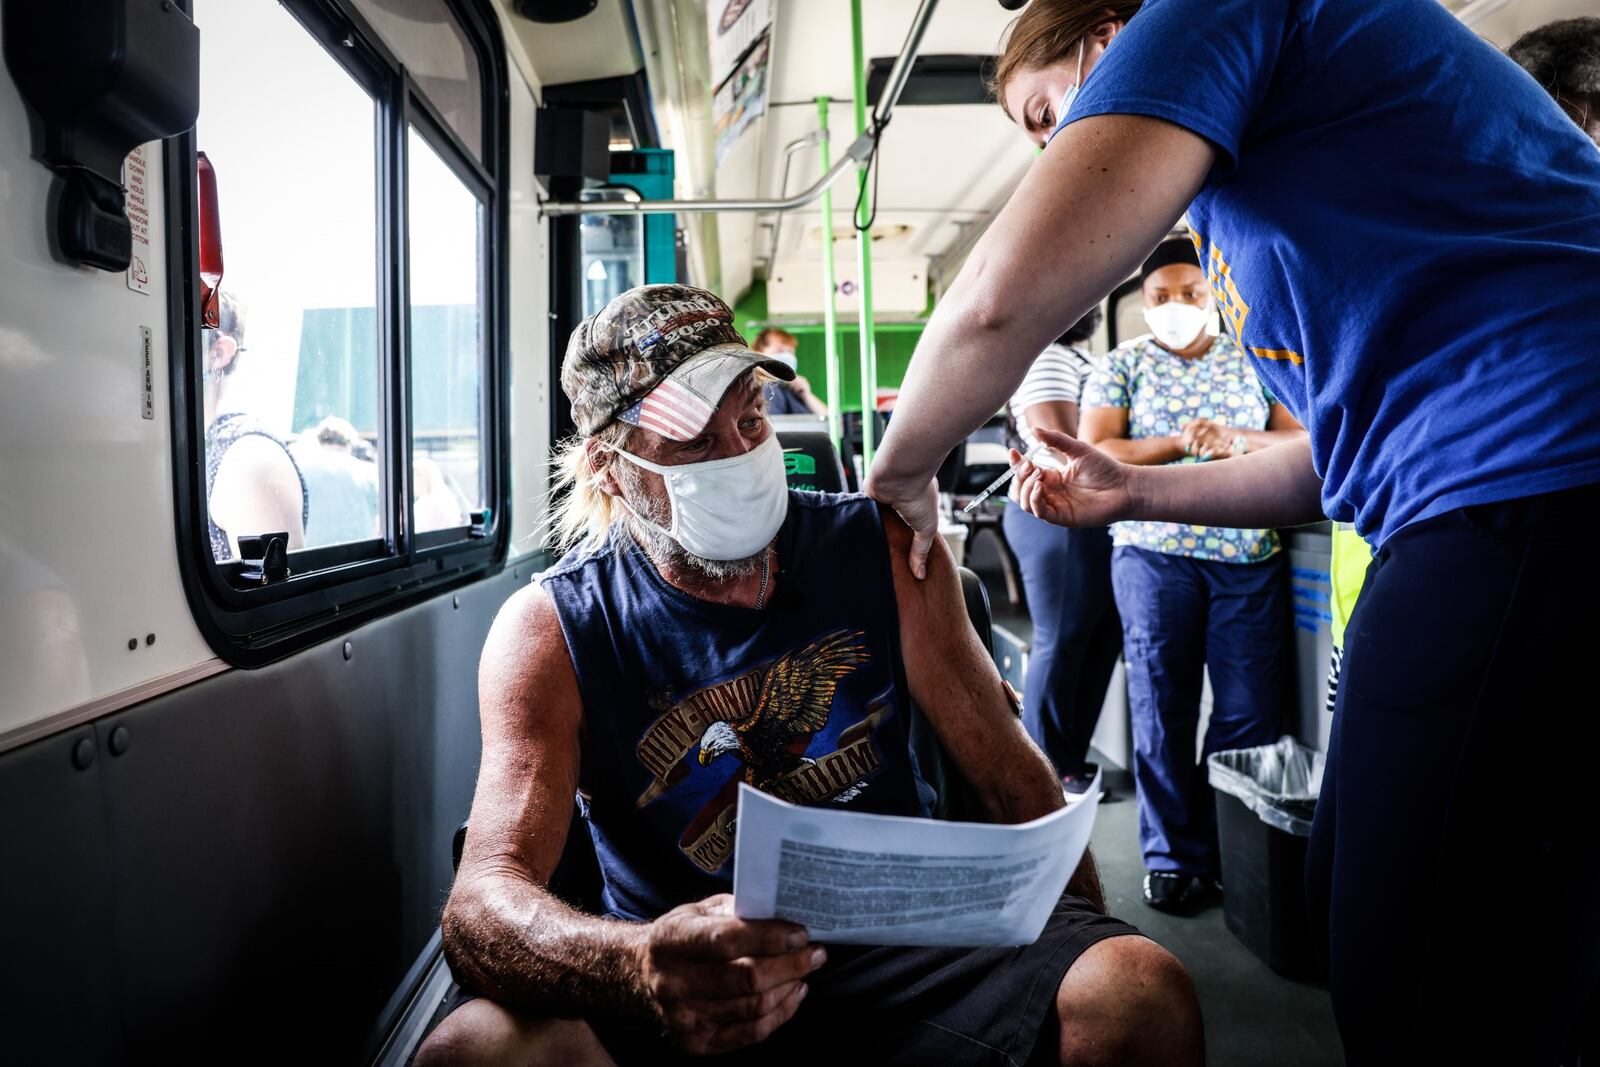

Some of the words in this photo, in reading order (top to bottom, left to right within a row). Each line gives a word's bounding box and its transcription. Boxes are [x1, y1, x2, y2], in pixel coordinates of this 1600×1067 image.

[129, 163, 145, 176] DOWN
[132, 175, 143, 185] AND
[130, 184, 145, 195] HOLD
[130, 193, 145, 206] WHILE
[127, 201, 148, 216] PUSHING
[131, 233, 149, 245] OTTOM
[626, 294, 717, 339] Trump
[664, 317, 720, 346] 2020
[147, 392, 152, 409] IN
[693, 833, 728, 867] 1776
